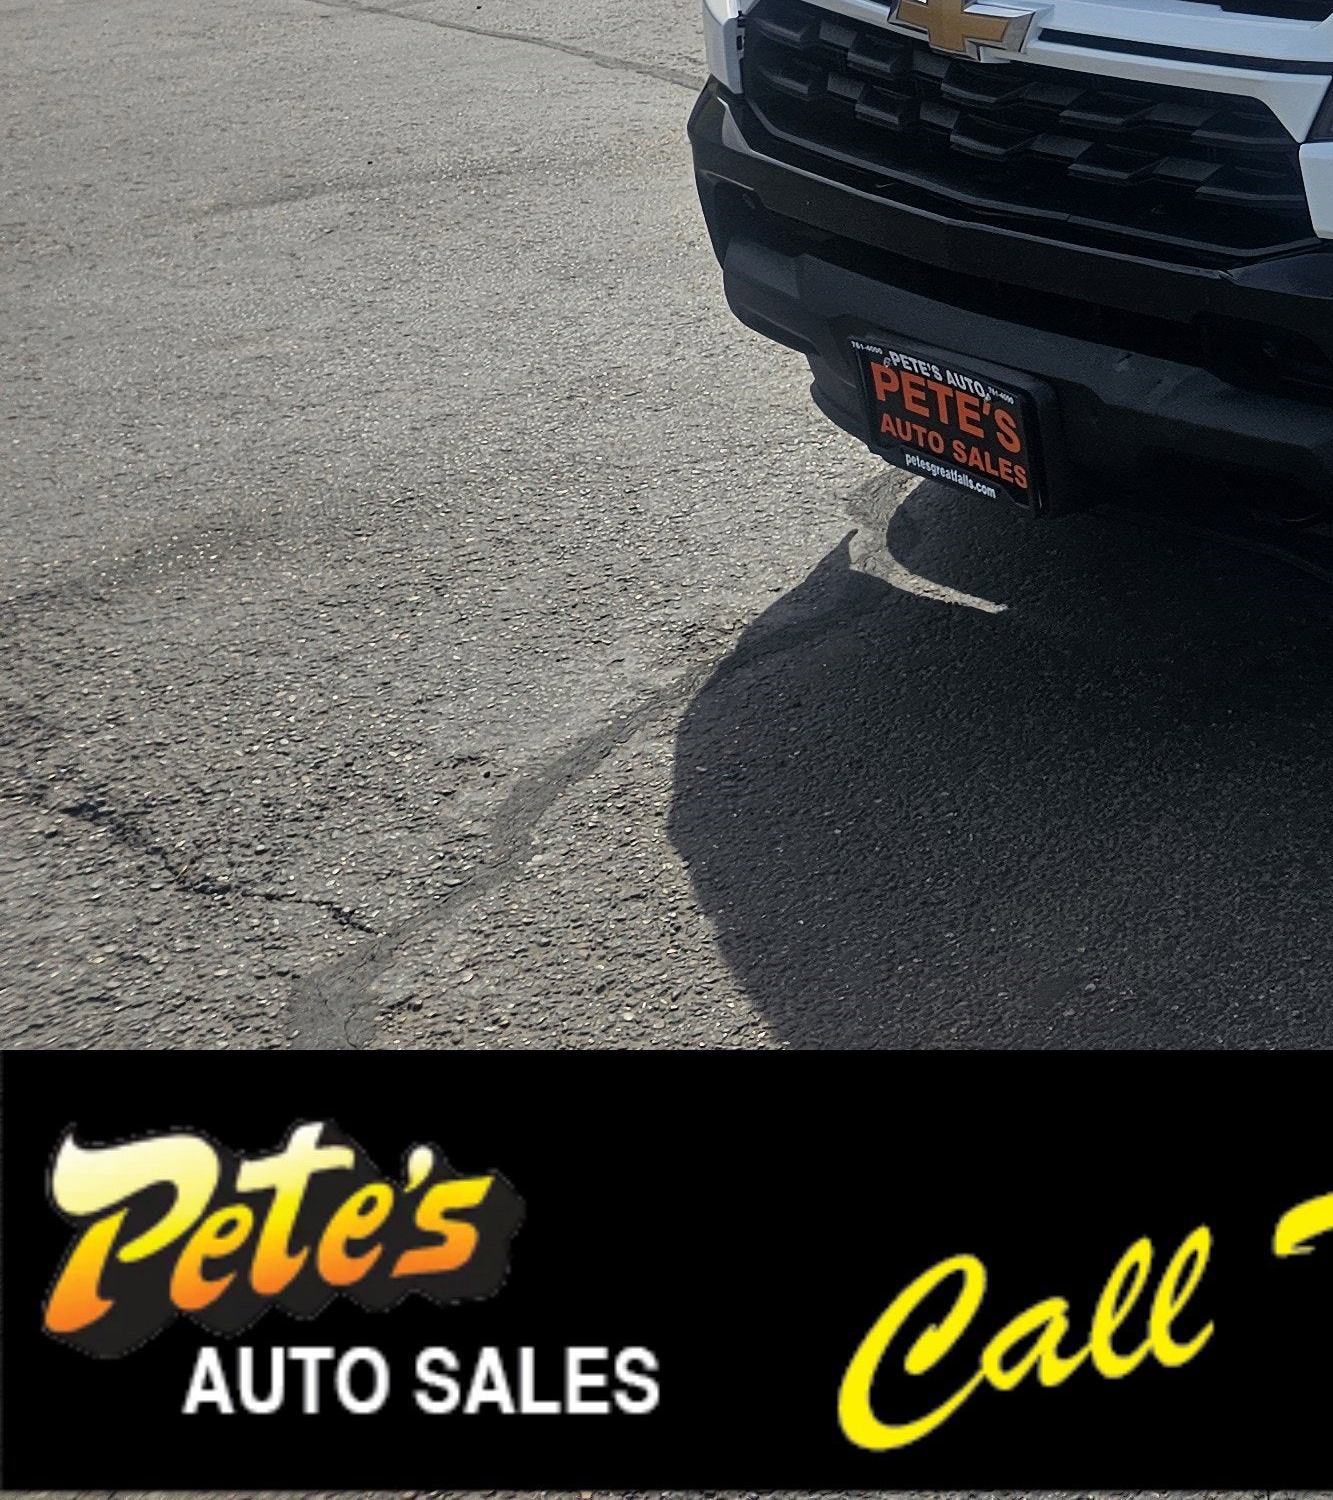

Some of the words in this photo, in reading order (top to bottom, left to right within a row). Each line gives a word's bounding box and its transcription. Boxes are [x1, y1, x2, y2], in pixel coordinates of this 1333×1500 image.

[888, 350, 943, 382] PETE'S
[945, 369, 986, 398] AUTO
[870, 361, 1021, 454] PETE'S
[880, 413, 945, 454] AUTO
[952, 439, 1028, 489] SALES
[905, 453, 997, 499] petesgreatfalls.com
